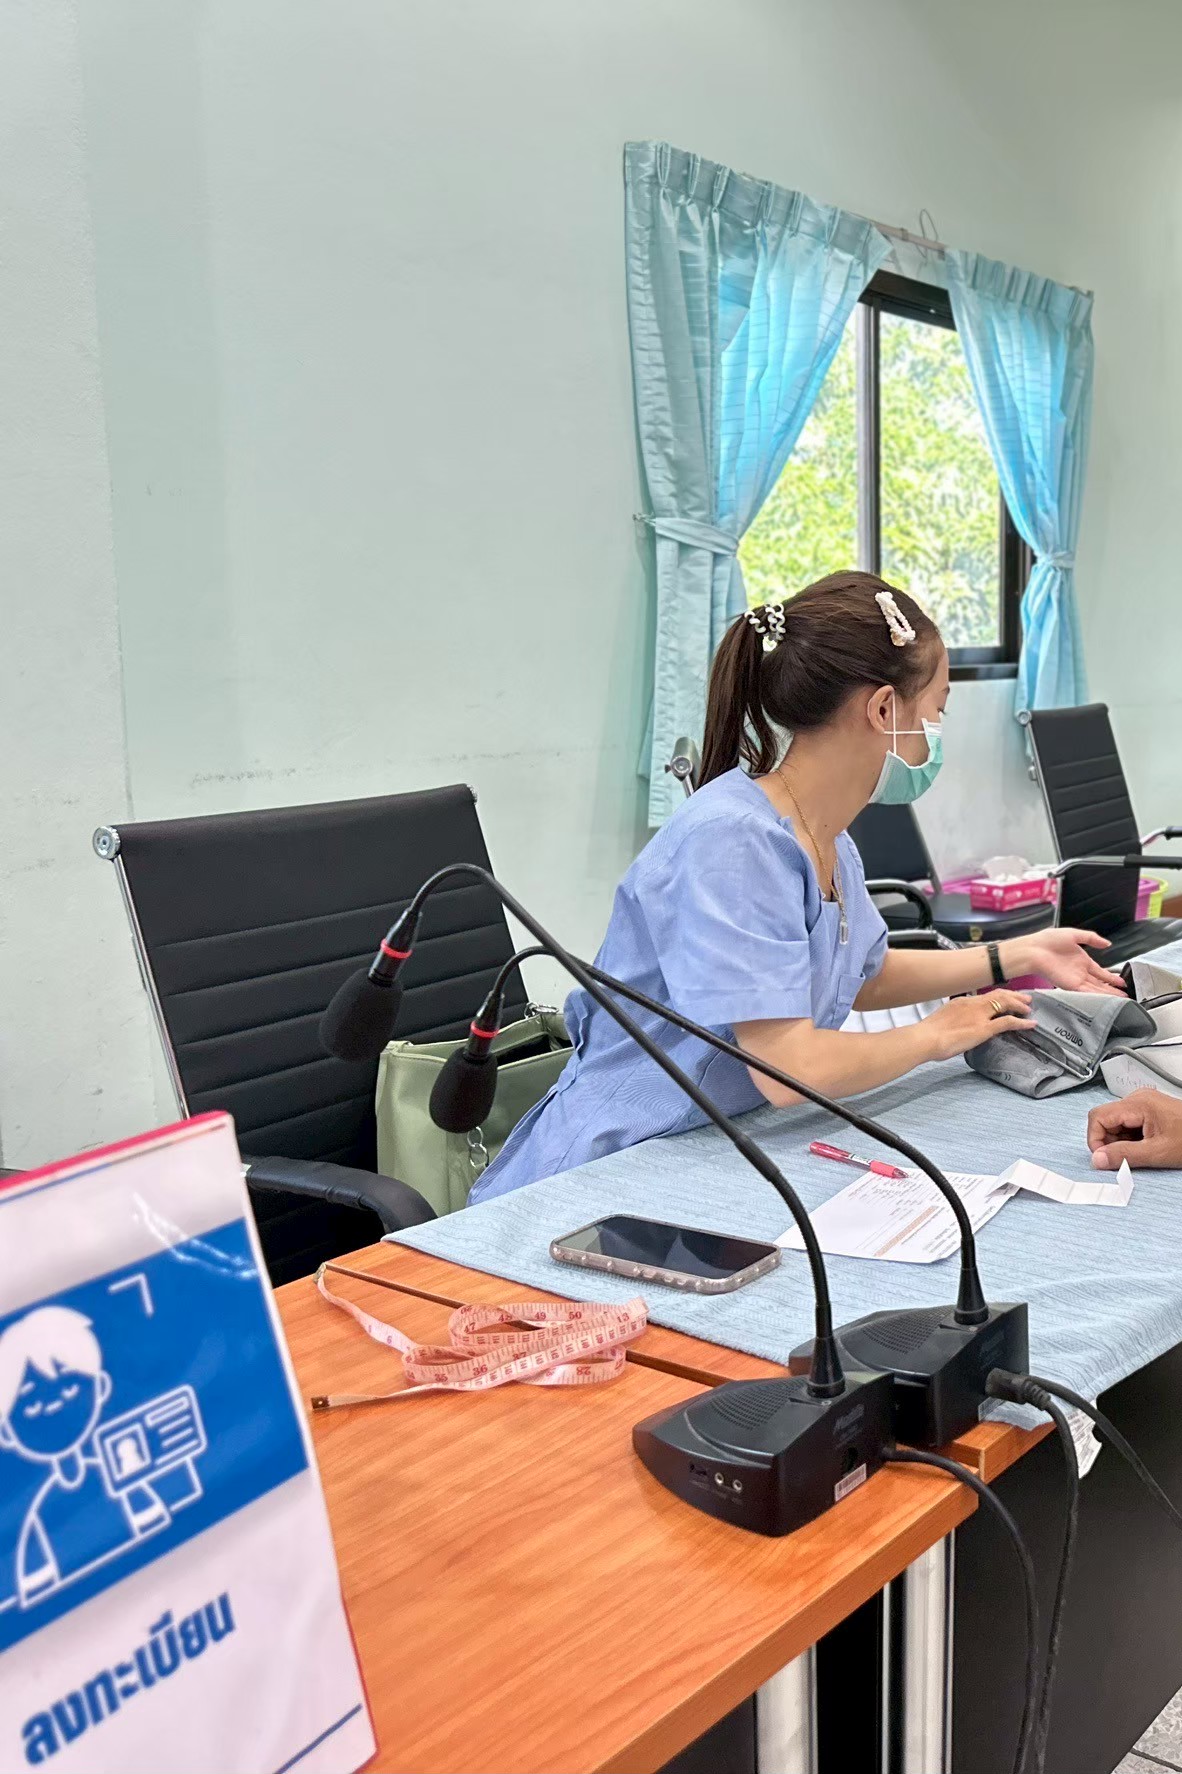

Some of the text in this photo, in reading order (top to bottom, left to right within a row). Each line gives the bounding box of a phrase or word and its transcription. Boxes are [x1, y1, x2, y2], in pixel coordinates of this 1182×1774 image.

[568, 1311, 582, 1320] 50
[617, 1312, 630, 1323] 13
[464, 1322, 476, 1334] 47
[472, 1364, 488, 1376] 36
[576, 1366, 592, 1376] 28
[19, 1591, 237, 1766] ลงทะเบียน
